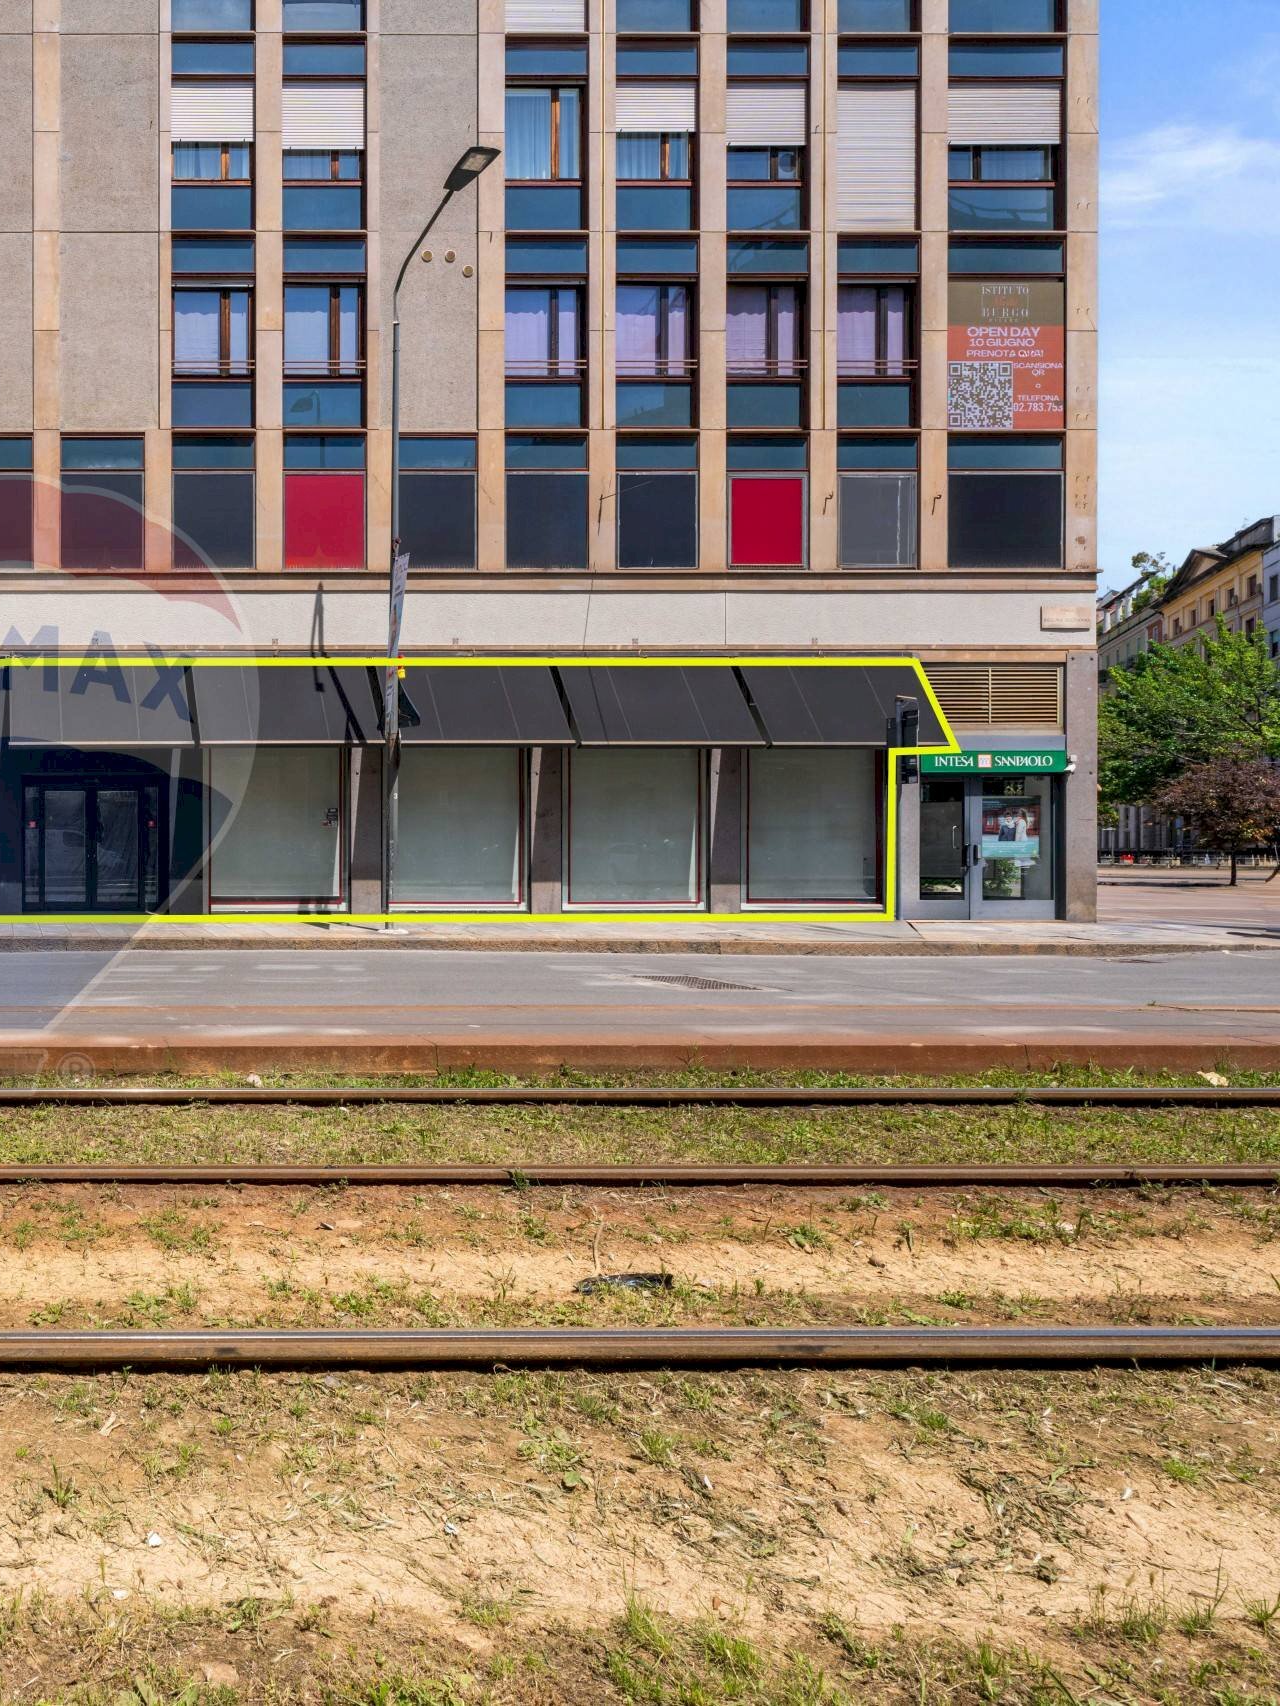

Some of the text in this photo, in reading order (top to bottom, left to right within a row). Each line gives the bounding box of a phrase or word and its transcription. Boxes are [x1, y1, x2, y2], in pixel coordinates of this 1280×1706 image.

[967, 326, 1041, 337] OPEN DAY
[969, 338, 1036, 347] 10 GIUGNO
[966, 349, 1016, 358] PRENOTA
[934, 755, 1053, 767] INTESA SANPAOLO
